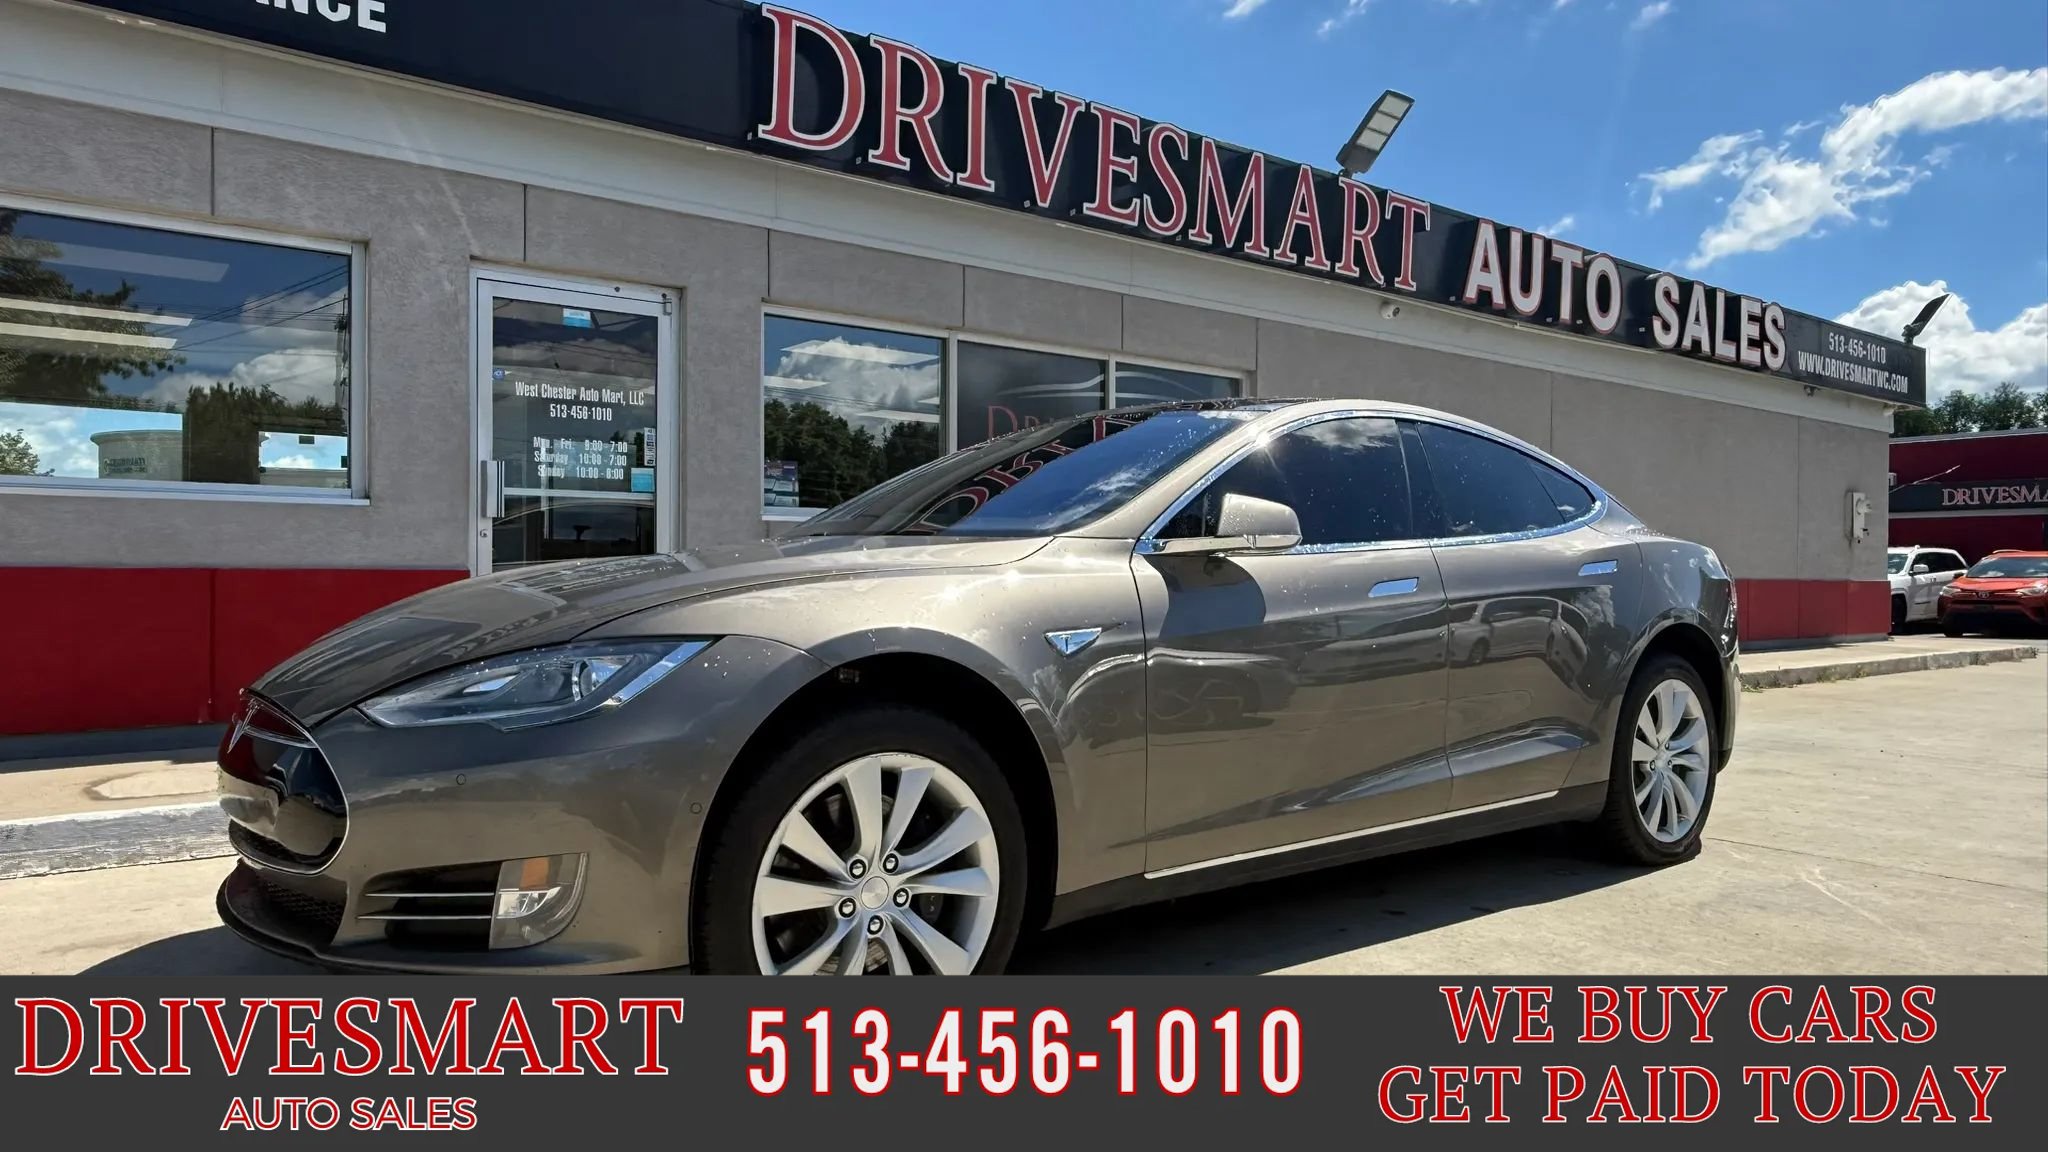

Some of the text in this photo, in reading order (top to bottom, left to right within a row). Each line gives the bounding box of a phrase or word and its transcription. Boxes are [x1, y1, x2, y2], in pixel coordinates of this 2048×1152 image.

[758, 2, 1786, 371] DRIVESMART AUTO SALES
[1828, 332, 1887, 364] 513-456-1010
[1798, 350, 1908, 394] WWW.DRIVESMARTWC.COM
[515, 381, 645, 406] West Chester Auto Mart, LLC
[610, 441, 628, 453] 7:00
[576, 466, 599, 479] 10:00
[579, 453, 602, 465] 10:00
[609, 454, 627, 467] 7:00
